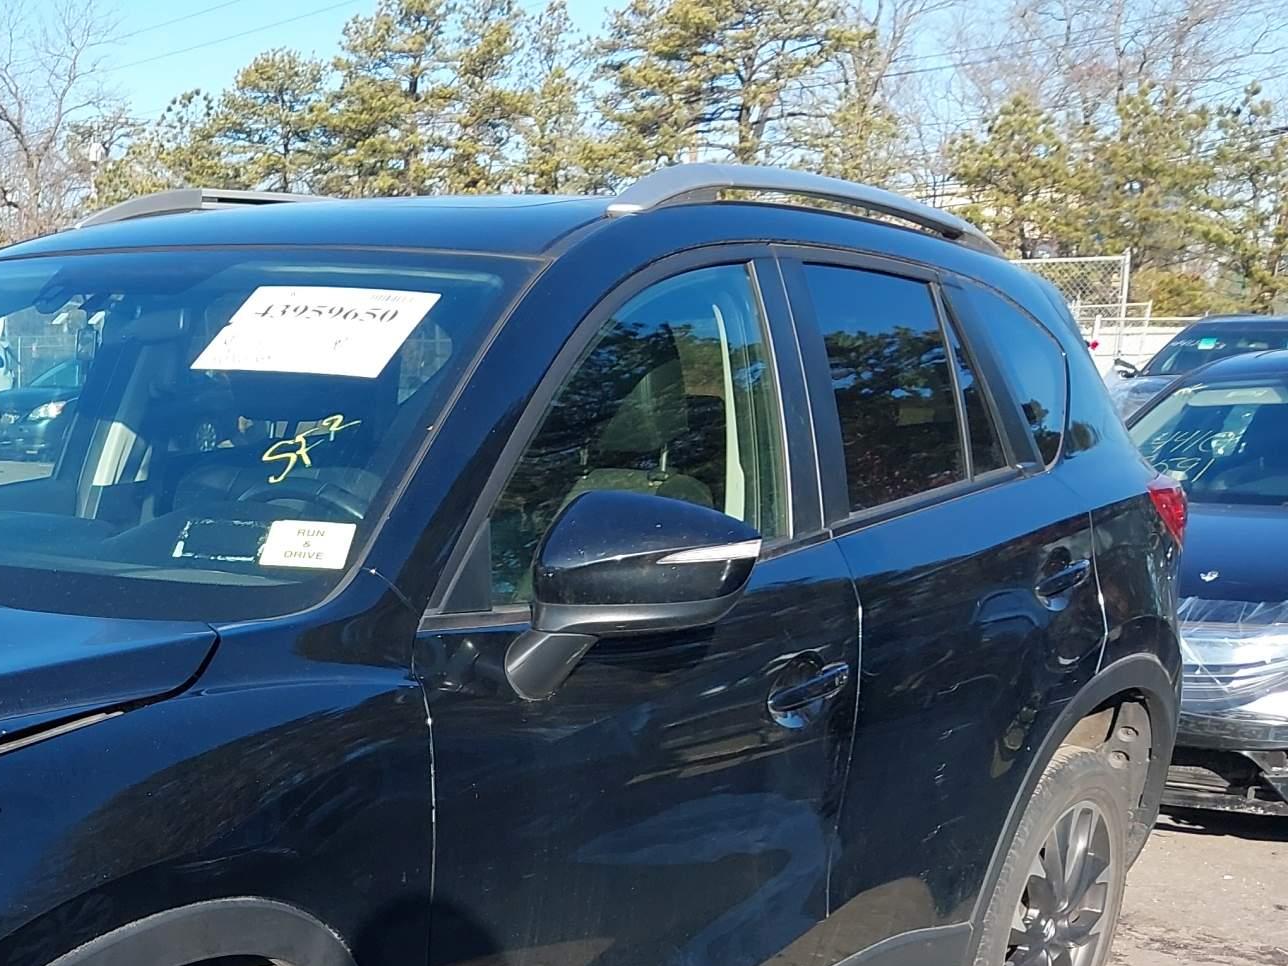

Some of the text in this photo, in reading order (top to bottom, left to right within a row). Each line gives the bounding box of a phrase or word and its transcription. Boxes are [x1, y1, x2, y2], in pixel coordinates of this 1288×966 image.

[254, 303, 400, 323] 43959650
[296, 528, 326, 537] RUN
[283, 550, 325, 560] DRIVE
